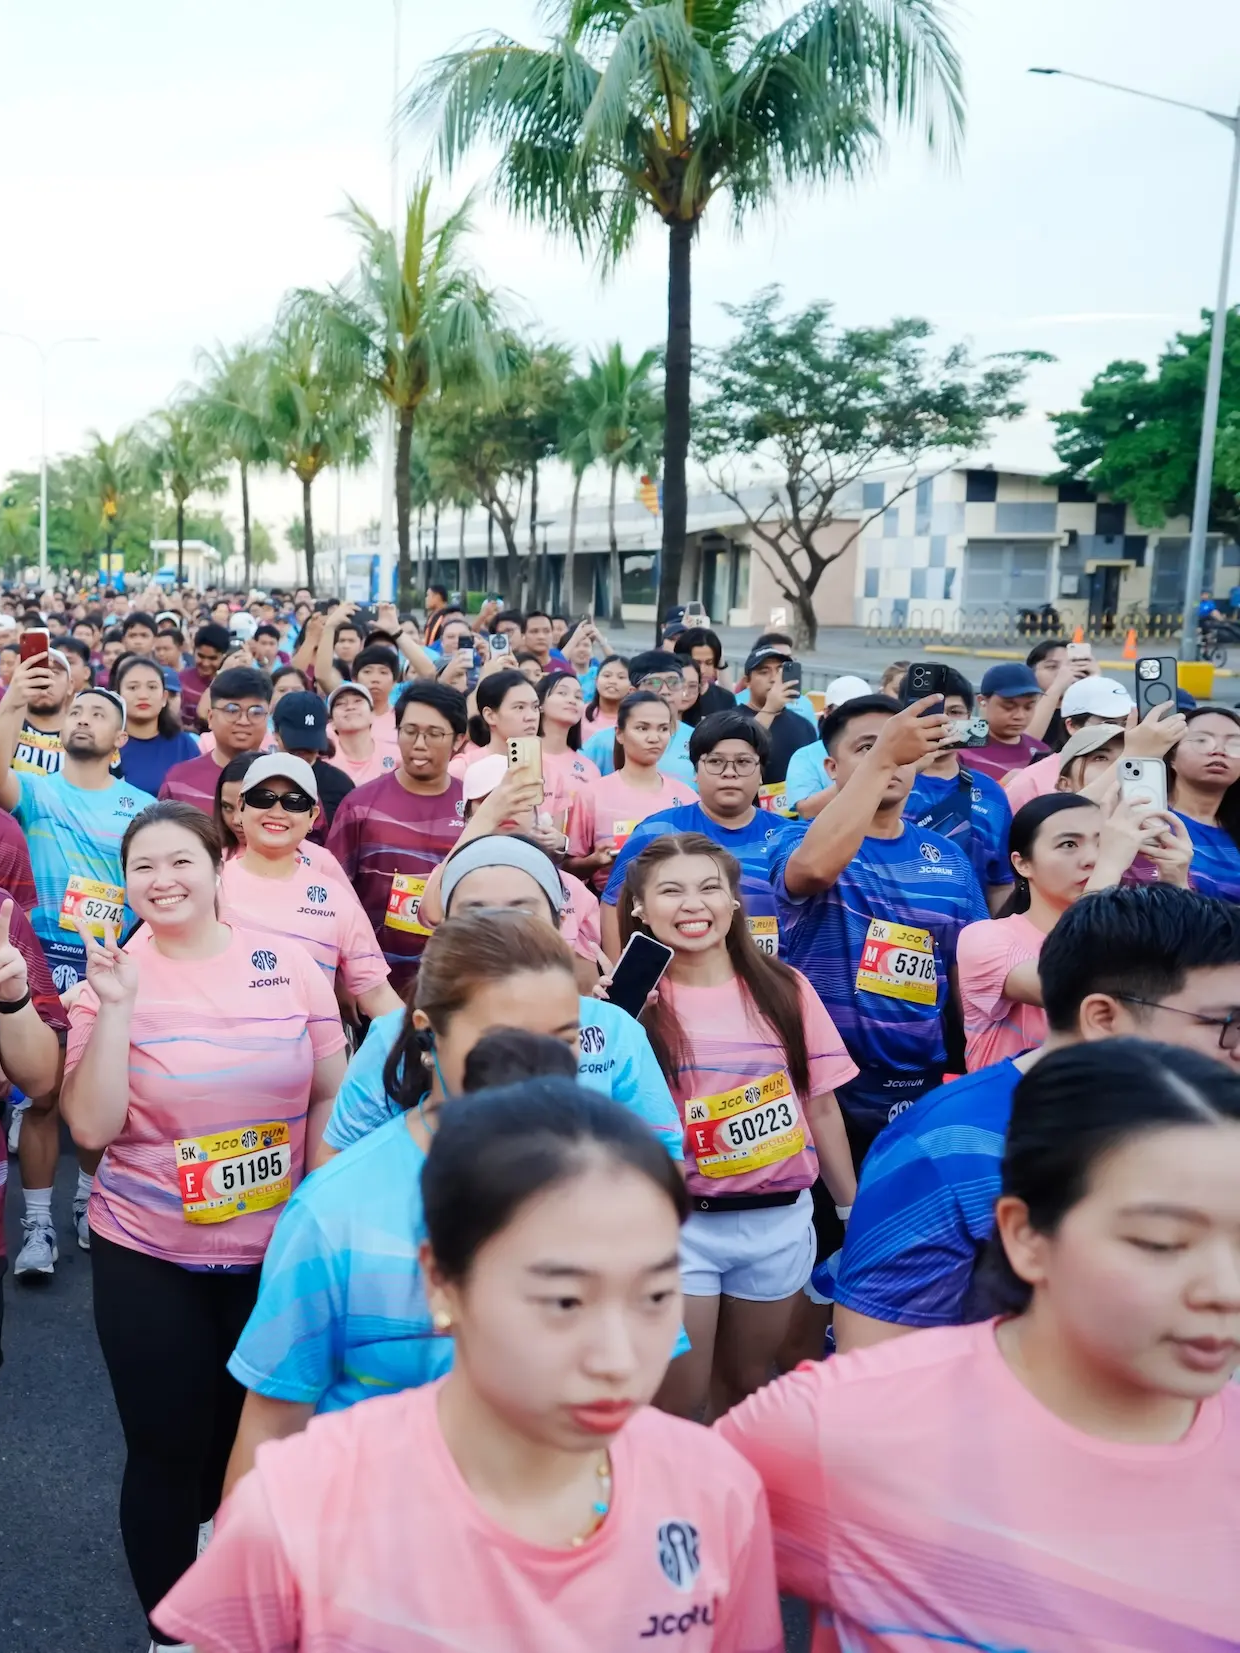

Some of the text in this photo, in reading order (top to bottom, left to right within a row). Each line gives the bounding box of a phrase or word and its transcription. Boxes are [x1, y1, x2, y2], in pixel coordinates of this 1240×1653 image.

[112, 810, 136, 818] JCOR
[917, 815, 933, 827] RUN
[448, 819, 464, 827] JCO
[918, 866, 953, 875] JCORUN
[296, 906, 336, 917] JCORUN
[872, 926, 922, 943] 5K JCO
[50, 942, 85, 954] JCORUN
[864, 945, 879, 963] M
[578, 1058, 616, 1075] CORUN
[882, 1079, 925, 1089] JCORUN
[690, 1078, 785, 1120] 5K JCO RUN
[728, 1103, 792, 1146] 50223
[181, 1127, 285, 1161] 5K JCO RUN
[695, 1130, 705, 1148] F
[222, 1151, 282, 1190] 51195
[185, 1172, 195, 1193] F
